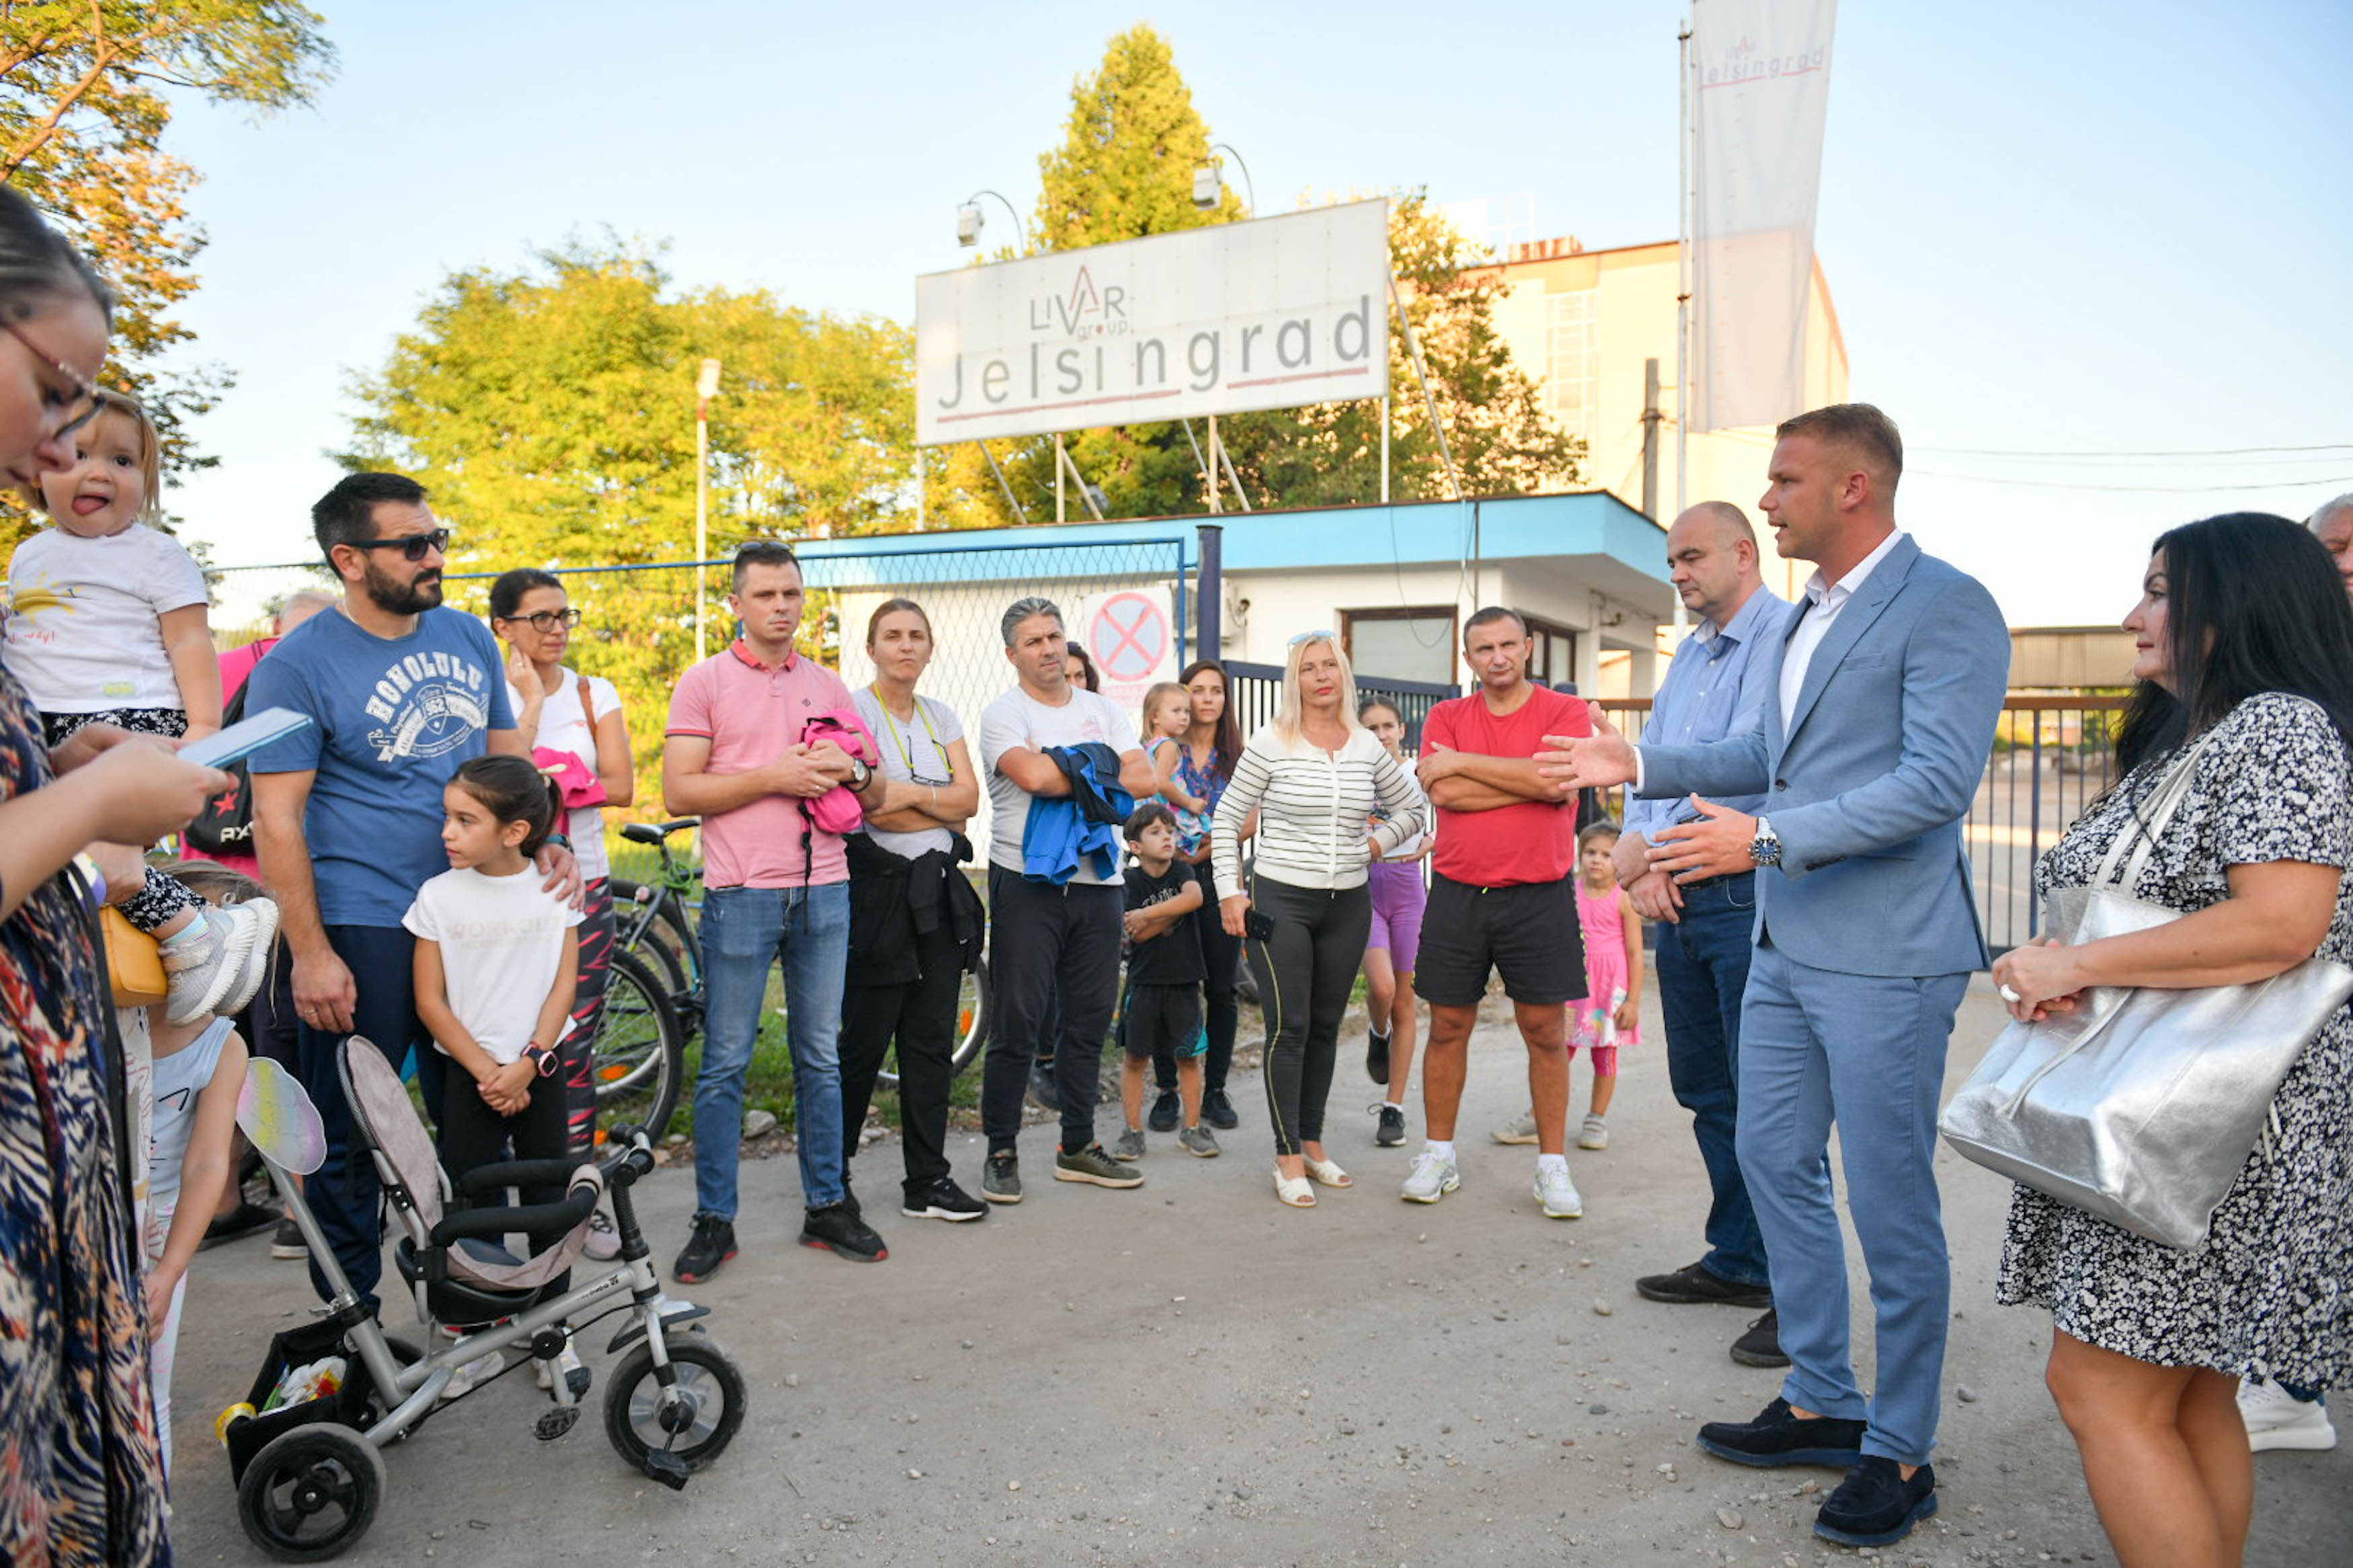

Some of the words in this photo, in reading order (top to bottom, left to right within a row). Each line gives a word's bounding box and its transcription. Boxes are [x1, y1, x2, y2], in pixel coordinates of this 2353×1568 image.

[1030, 265, 1126, 335] LIVAR
[939, 294, 1369, 409] Jelsingrad
[365, 651, 483, 725] HONOLULU
